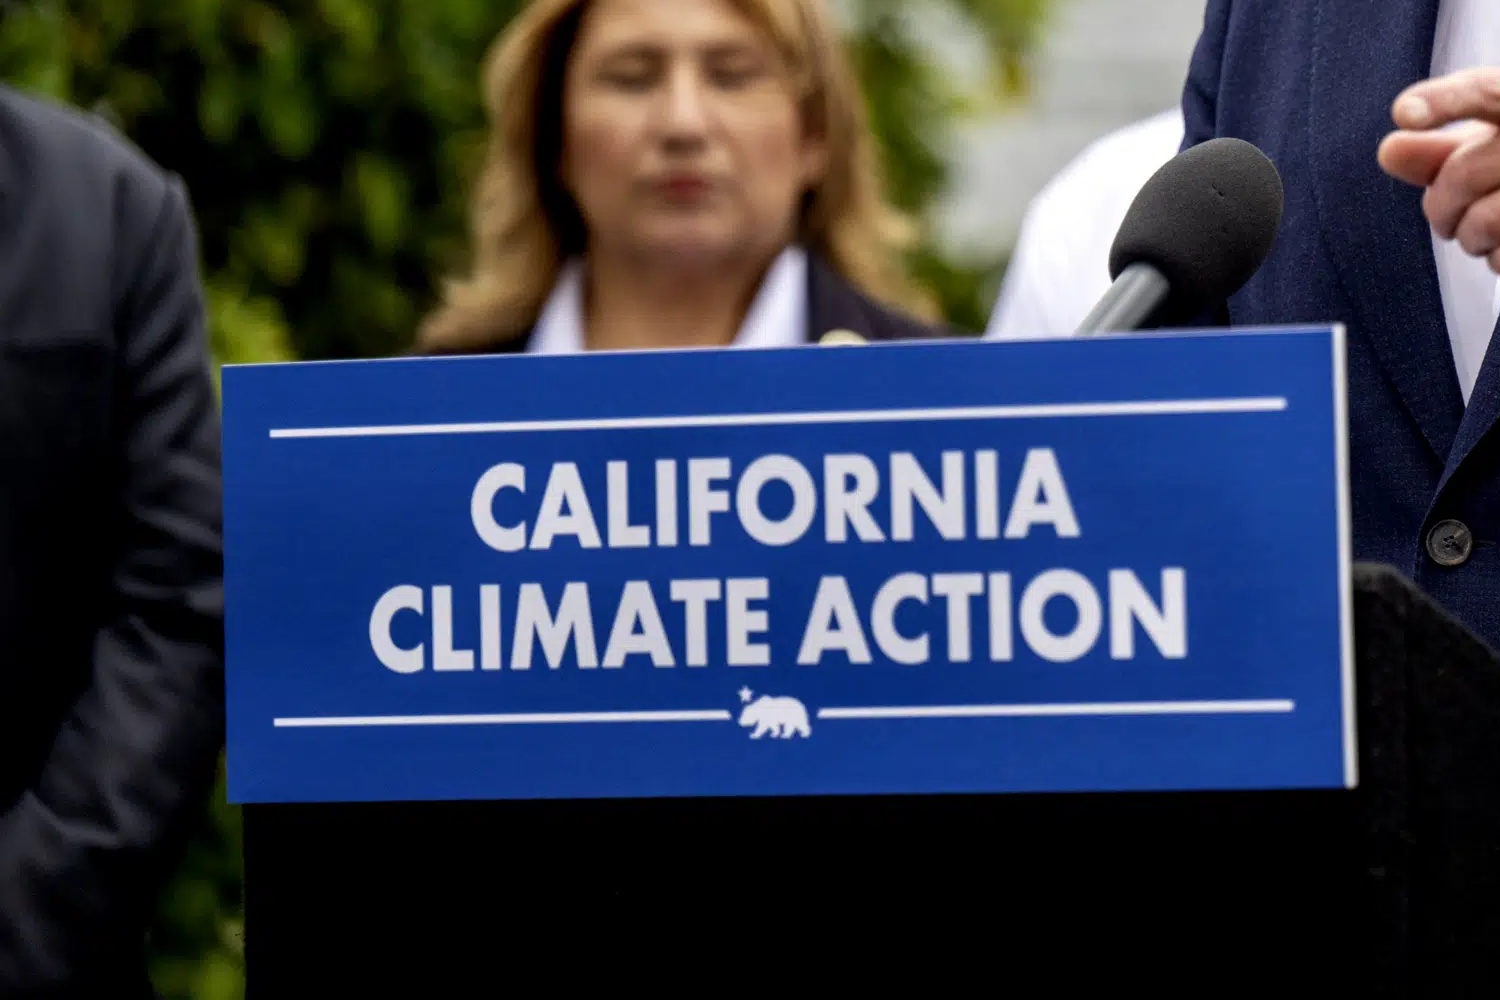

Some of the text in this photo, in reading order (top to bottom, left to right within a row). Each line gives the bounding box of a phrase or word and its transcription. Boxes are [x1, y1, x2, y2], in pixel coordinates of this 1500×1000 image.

[470, 447, 1081, 552] CALIFORNIA
[368, 568, 1188, 673] CLIMATE ACTION
